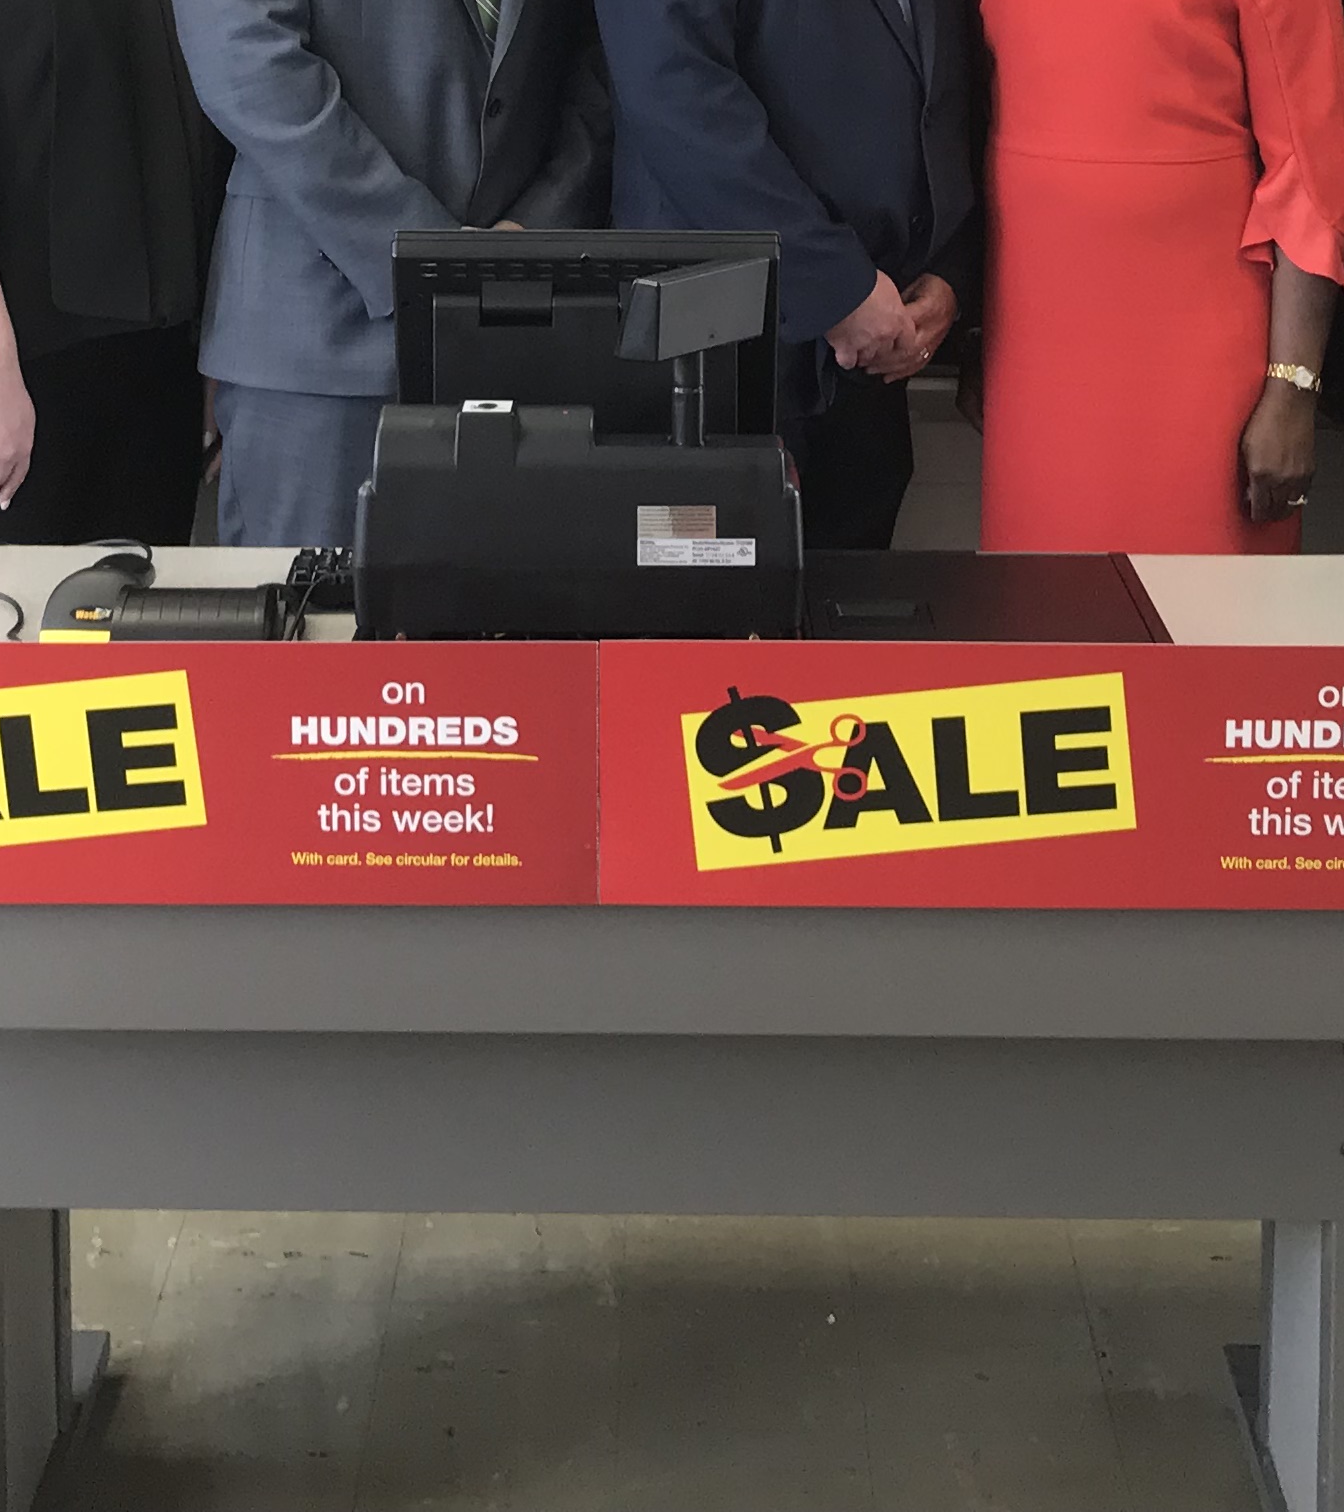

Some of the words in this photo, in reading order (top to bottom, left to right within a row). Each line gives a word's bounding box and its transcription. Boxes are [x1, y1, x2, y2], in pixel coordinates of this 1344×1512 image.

[381, 681, 425, 705] on
[291, 716, 519, 746] HUNDREDS
[334, 766, 370, 796] of
[380, 766, 476, 797] items
[1266, 770, 1303, 800] of
[317, 802, 382, 833] this
[391, 803, 494, 833] week!
[1248, 806, 1312, 836] this
[291, 851, 323, 866] With
[326, 852, 362, 866] card.
[365, 851, 393, 866] See
[395, 852, 448, 867] circular
[450, 852, 471, 867] for
[472, 853, 523, 867] details.
[1220, 855, 1253, 870] With
[1255, 856, 1291, 870] card.
[1294, 856, 1323, 870] See
